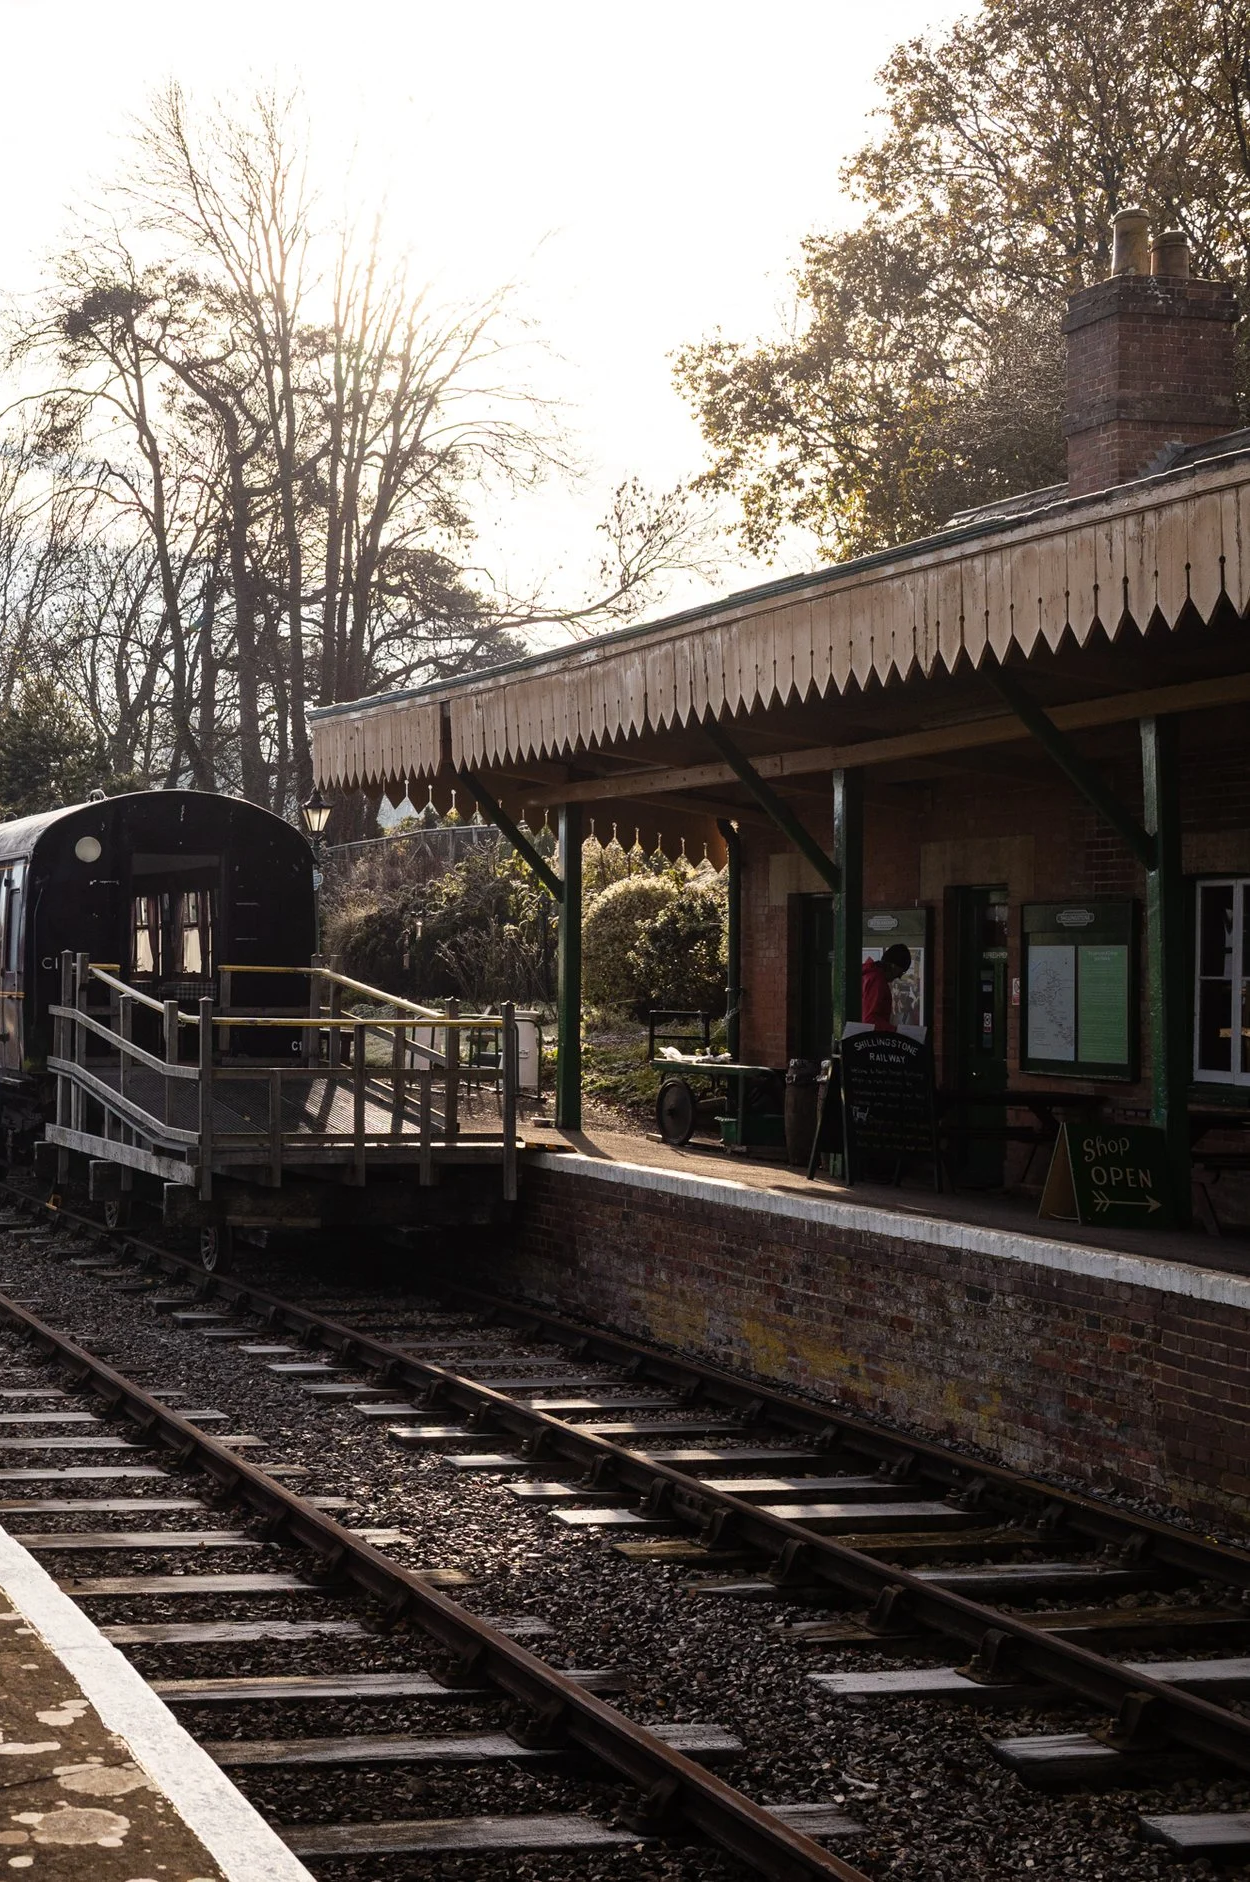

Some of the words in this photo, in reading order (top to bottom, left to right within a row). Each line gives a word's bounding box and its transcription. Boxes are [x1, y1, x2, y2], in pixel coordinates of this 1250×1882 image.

[853, 1037, 919, 1056] SHILLINGSTONE
[869, 1052, 906, 1064] RAILWAY
[1082, 1135, 1130, 1162] Shop
[1090, 1165, 1153, 1188] OPEN
